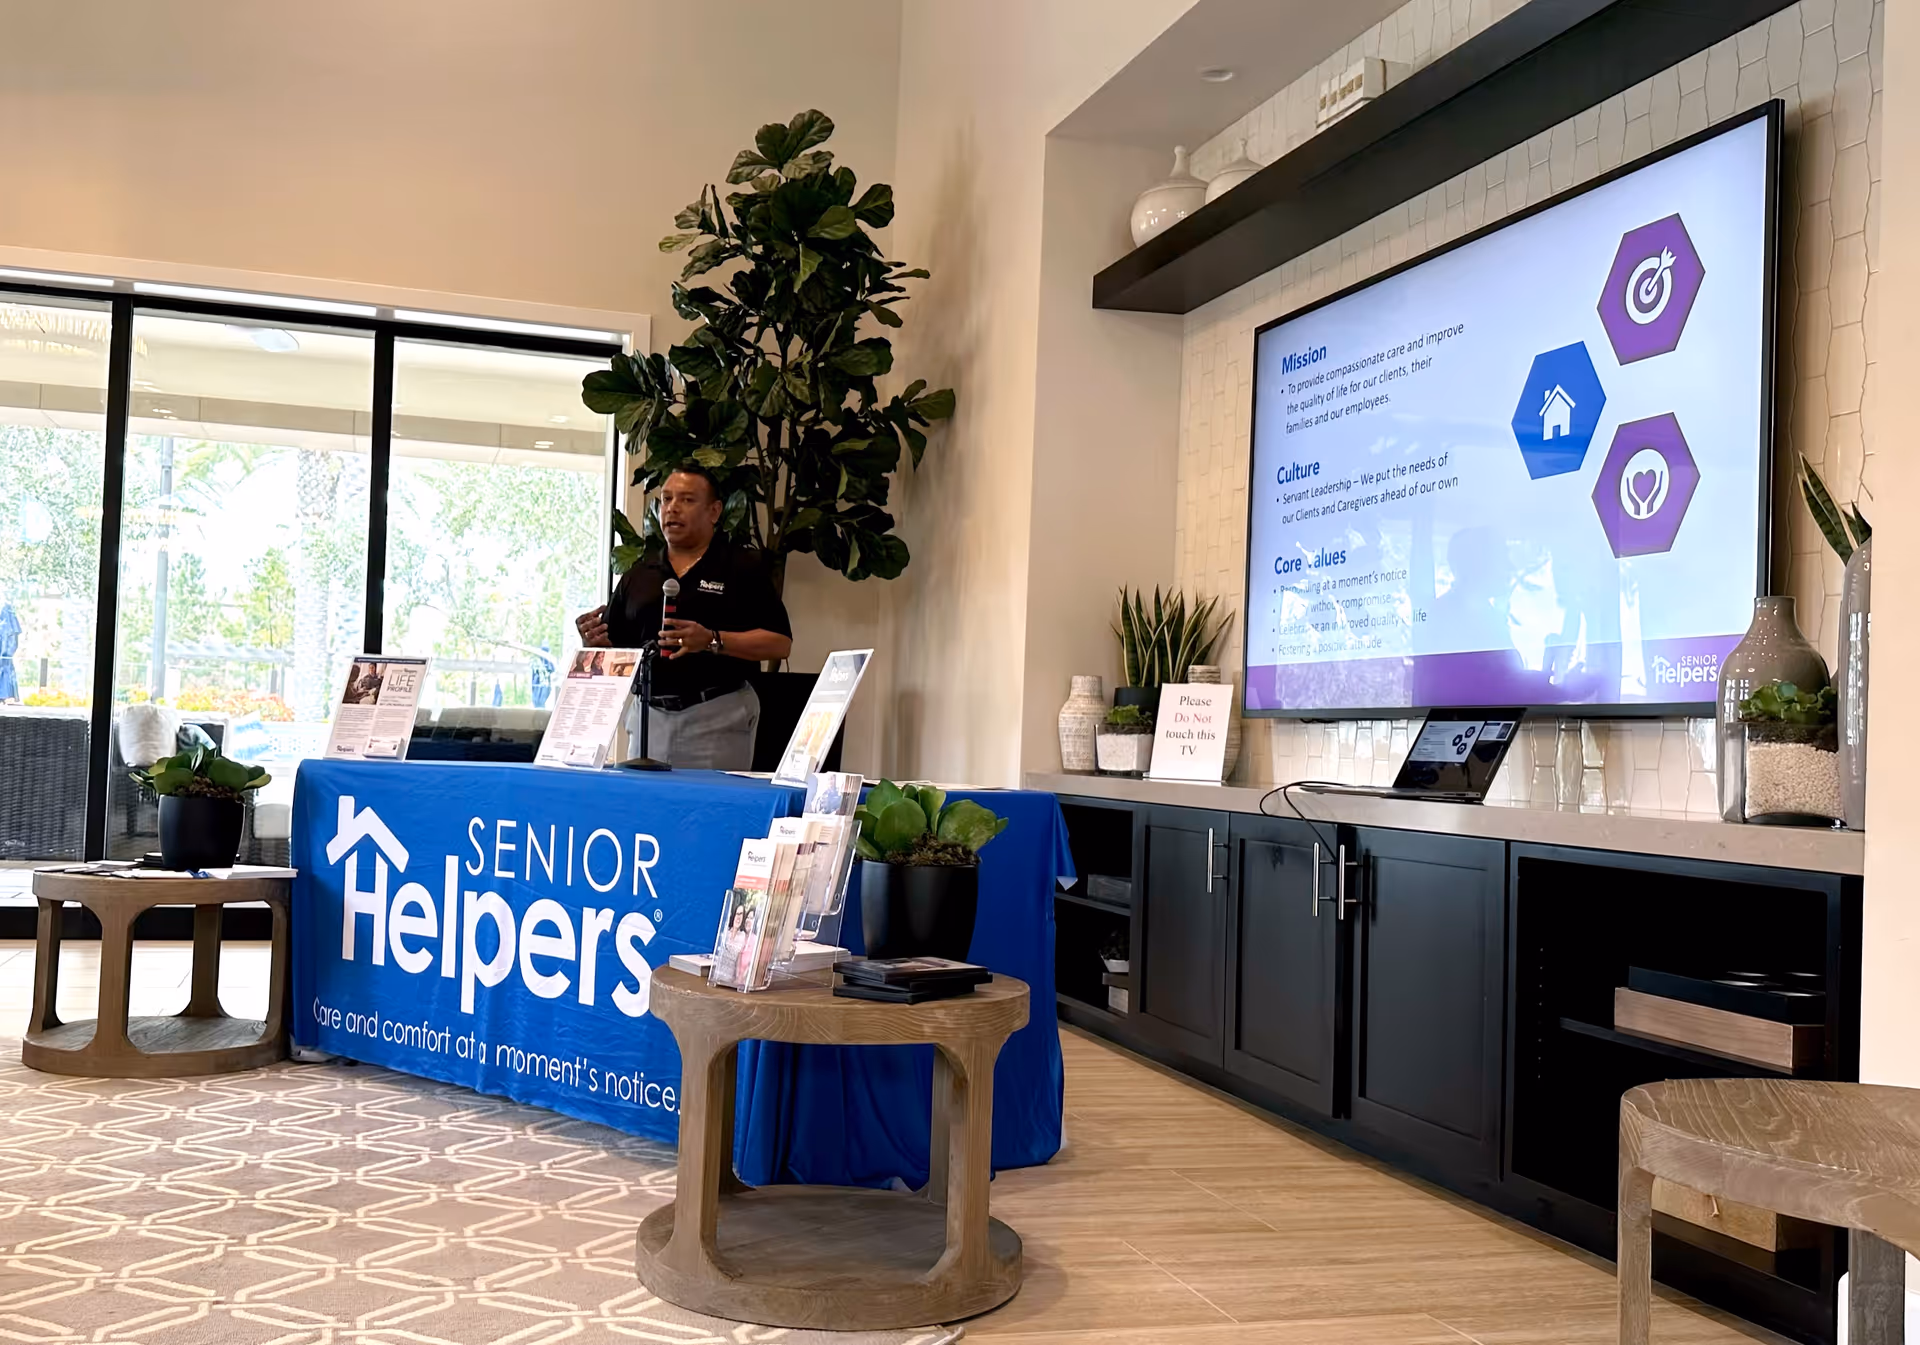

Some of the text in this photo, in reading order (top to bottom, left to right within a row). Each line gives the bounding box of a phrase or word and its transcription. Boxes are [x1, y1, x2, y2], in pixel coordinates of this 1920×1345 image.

[1281, 344, 1327, 375] Mission
[1288, 322, 1464, 395] To provide compassionate care and improve
[1286, 355, 1433, 415] the quality of life for our clients, their
[1286, 392, 1391, 434] families and our employees.
[1277, 460, 1320, 485] Culture
[1282, 488, 1309, 505] Servant
[1311, 478, 1352, 499] Leadership
[1361, 472, 1374, 487] We
[1376, 467, 1391, 484] put
[1392, 463, 1407, 478] the
[1409, 456, 1436, 474] needs
[1438, 452, 1449, 468] of
[1282, 475, 1458, 525] our Clients and Caregivers ahead of our own
[1274, 556, 1301, 575] Core
[1322, 579, 1330, 590] at
[1331, 580, 1337, 589] a
[1338, 571, 1379, 589] moment's
[1380, 568, 1407, 582] notice
[1341, 593, 1392, 610] compromise
[1279, 621, 1320, 635] Celebrang
[1321, 621, 1330, 631] an
[1331, 614, 1369, 631] imoved
[1371, 610, 1400, 629] quality
[1413, 608, 1427, 622] life
[1350, 636, 1382, 651] attude
[1681, 654, 1717, 666] SENIOR
[388, 674, 417, 687] LIFE
[1655, 662, 1718, 688] Helpers
[1179, 695, 1212, 706] Please
[1174, 712, 1212, 724] Do Not
[1165, 729, 1216, 740] touch this
[1180, 745, 1197, 756] TV
[465, 815, 661, 899] SENIOR
[313, 996, 681, 1116] Care and comfort at a moment's notice.
